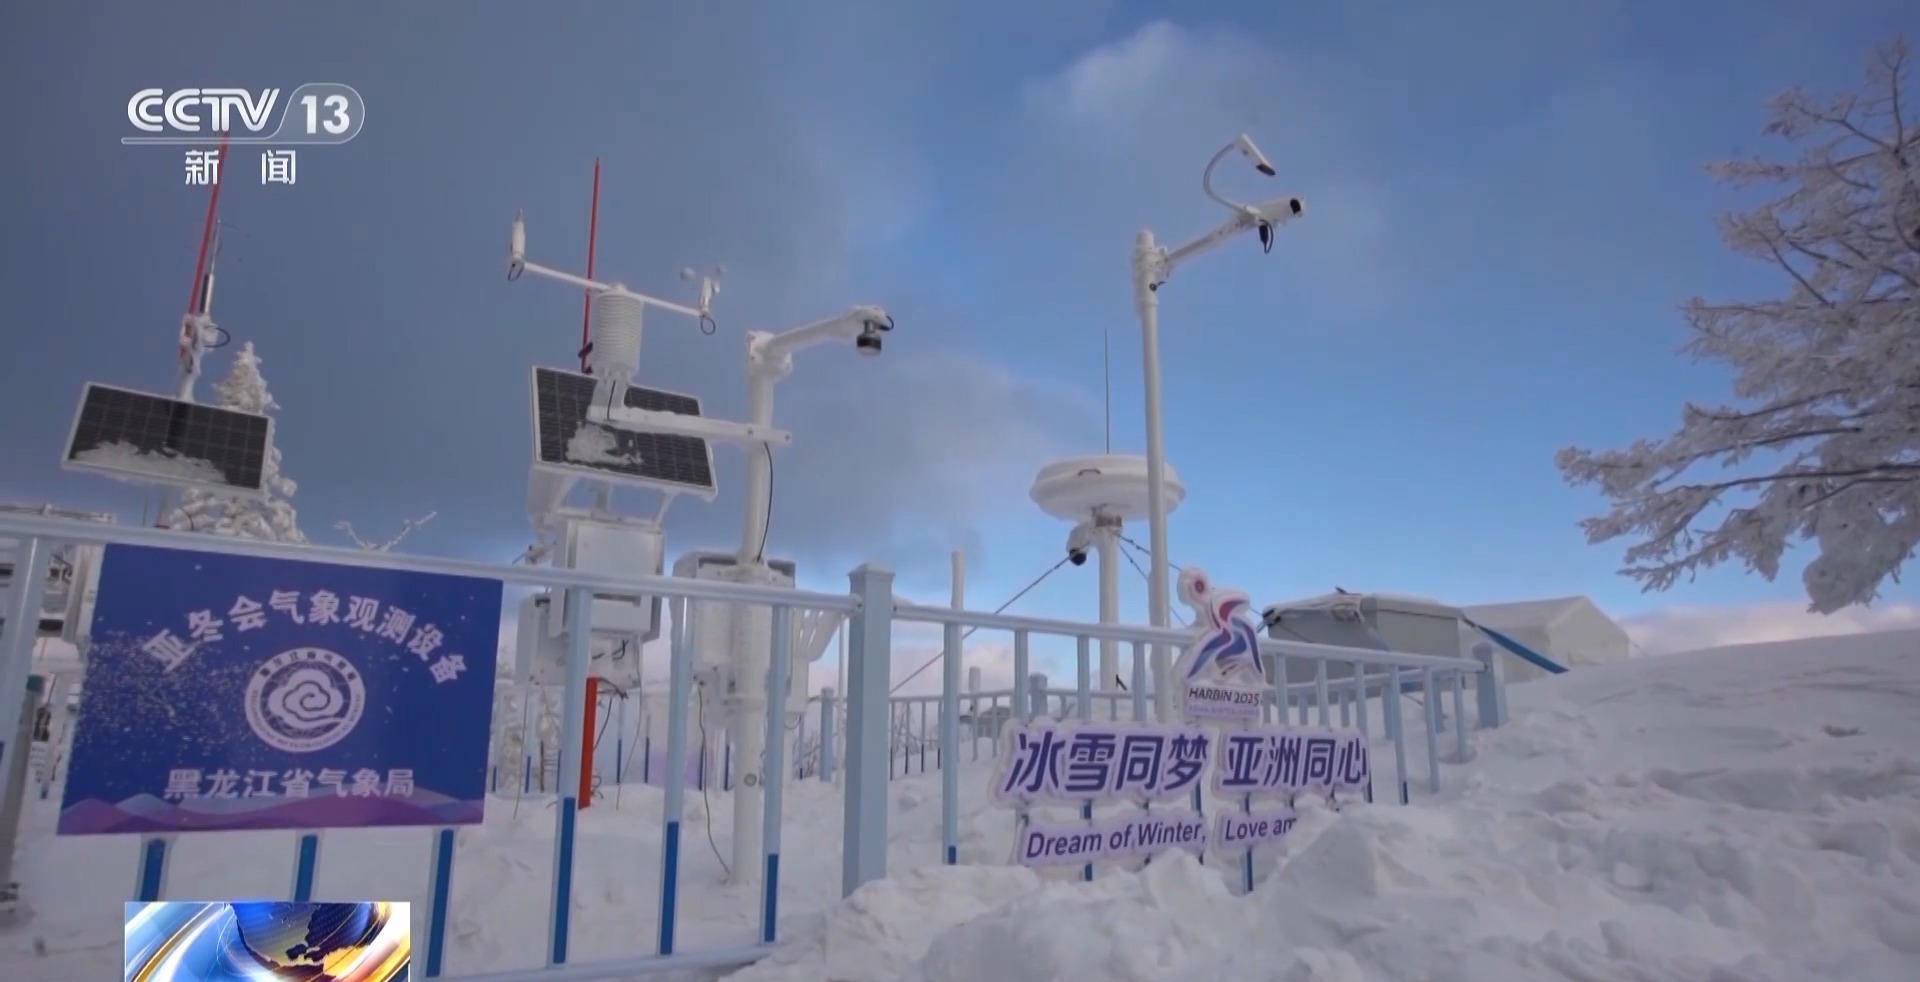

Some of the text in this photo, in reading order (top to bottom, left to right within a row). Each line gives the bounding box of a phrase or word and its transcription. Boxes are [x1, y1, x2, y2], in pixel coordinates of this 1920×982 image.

[142, 588, 468, 685] 亚冬会气象观测设备
[1188, 687, 1260, 706] HARBIN 2025
[1004, 731, 1368, 794] 冰雪同梦 亚洲同心
[164, 767, 415, 801] 黑龙江省气象局
[1026, 831, 1102, 860] Dream
[1109, 824, 1134, 849] of
[1138, 819, 1207, 847] Winter,
[1225, 819, 1268, 842] Love
